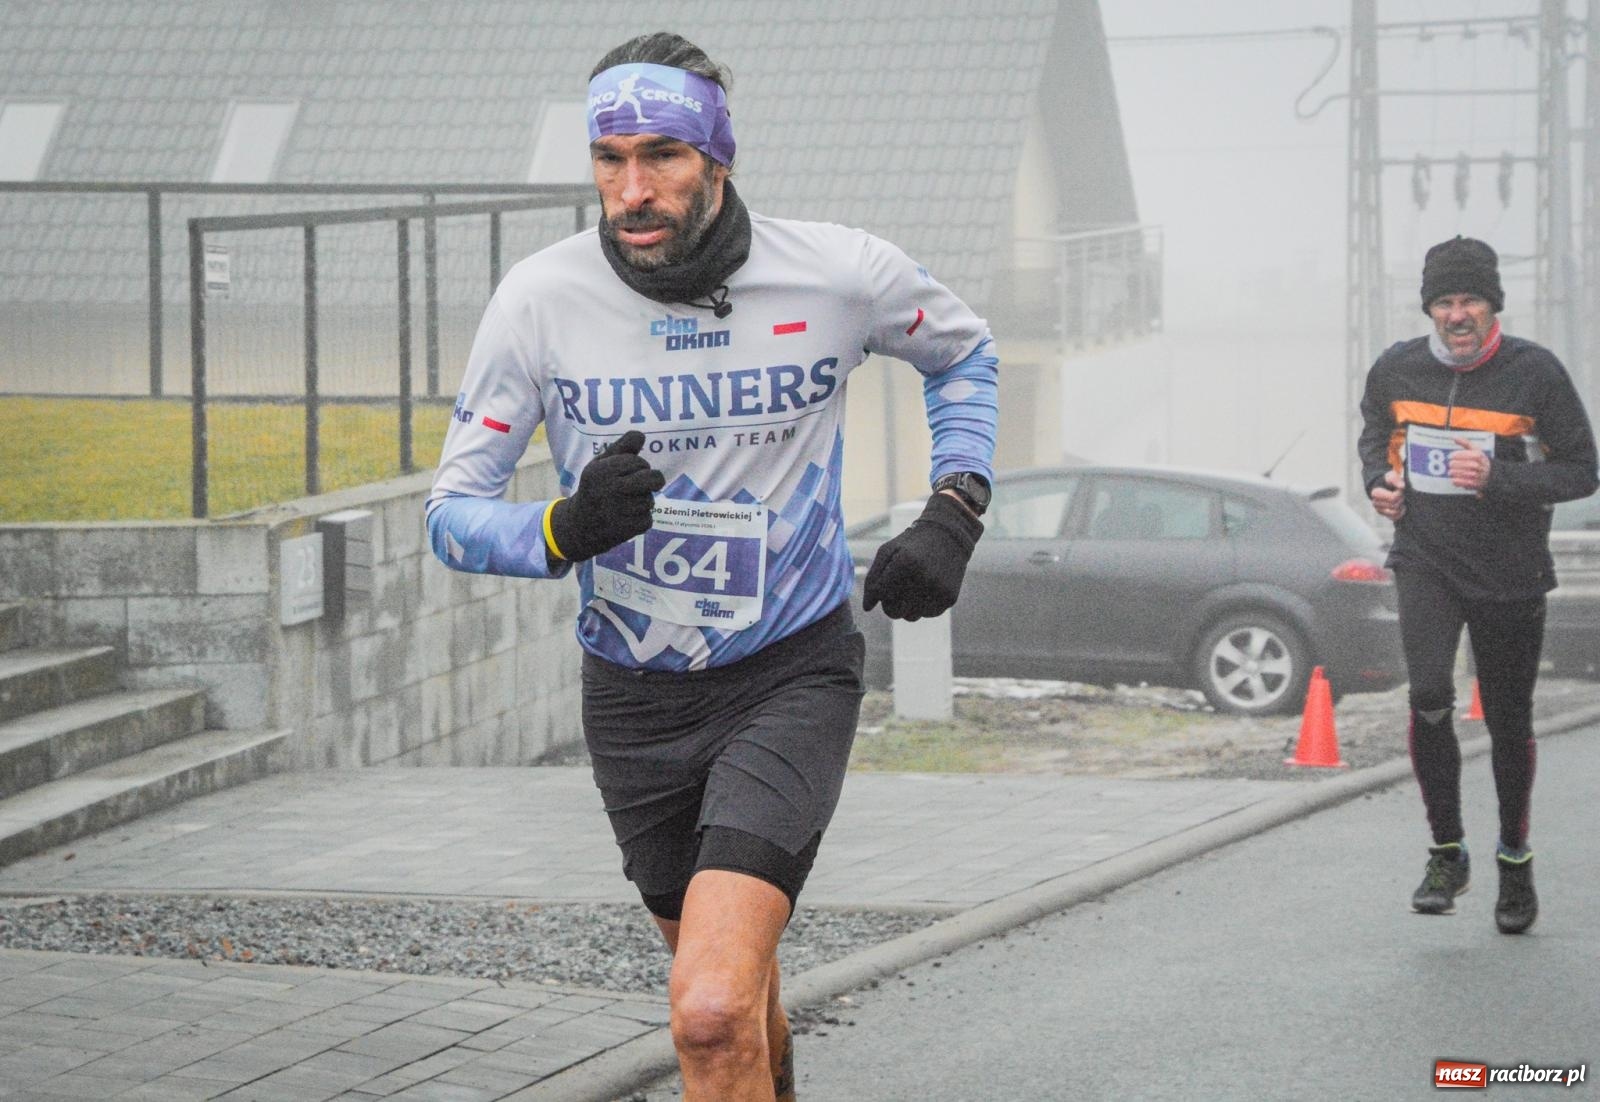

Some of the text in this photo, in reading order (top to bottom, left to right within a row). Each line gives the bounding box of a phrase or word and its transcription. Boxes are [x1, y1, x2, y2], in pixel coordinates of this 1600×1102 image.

[641, 88, 703, 113] CROSS
[554, 357, 838, 425] RUNNERS
[734, 426, 796, 447] TEAM
[664, 506, 690, 517] Ziemi
[691, 509, 753, 522] Pietrowickiej
[626, 533, 731, 591] 164
